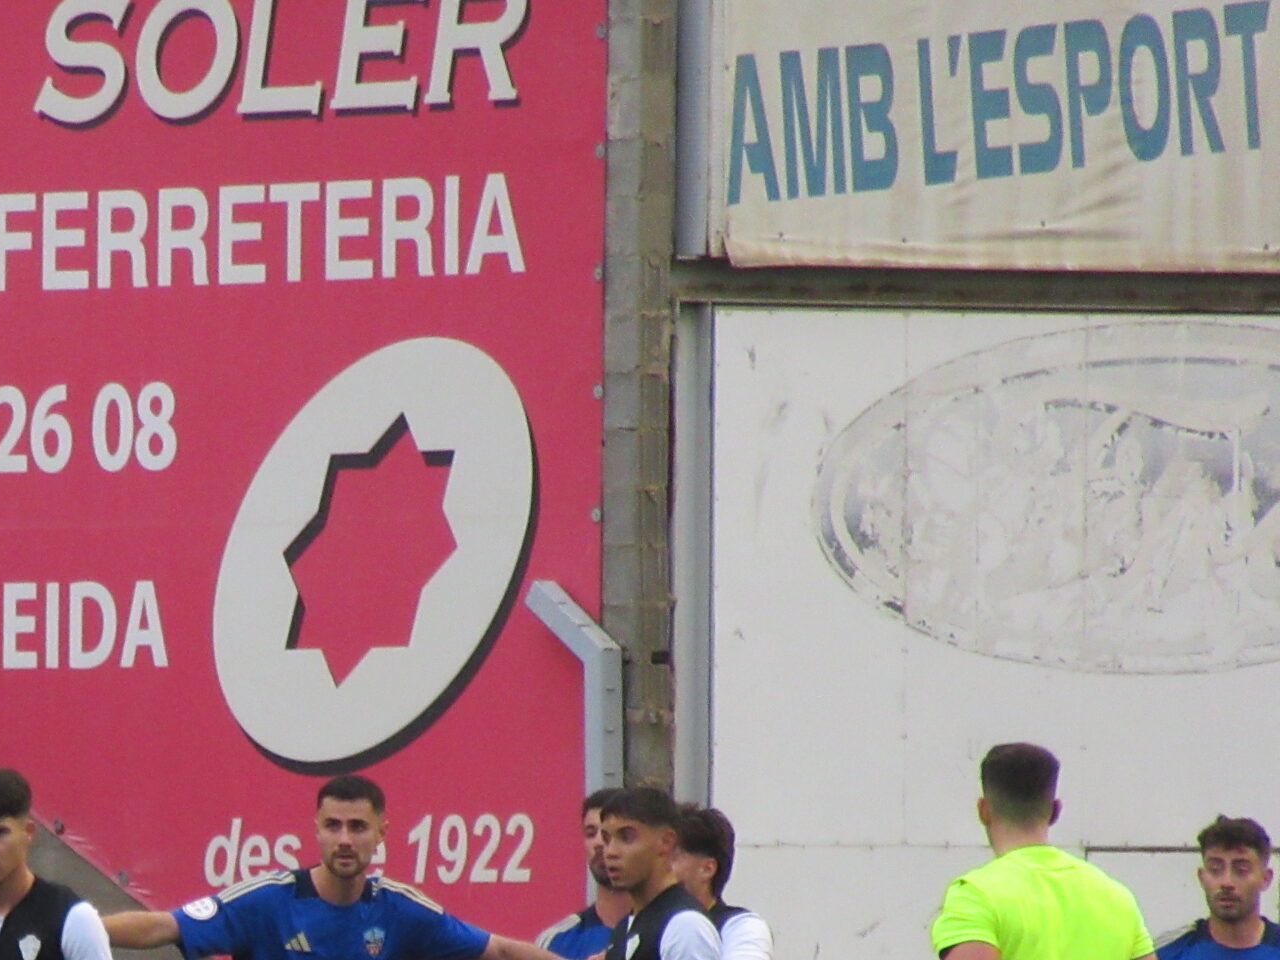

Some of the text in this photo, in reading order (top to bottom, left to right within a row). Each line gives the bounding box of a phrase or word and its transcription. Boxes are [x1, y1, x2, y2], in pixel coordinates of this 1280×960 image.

[33, 0, 530, 128] SOLER
[727, 0, 1271, 206] AMB L'ESPORT
[91, 381, 177, 472] 08
[204, 812, 534, 887] dese 1922
